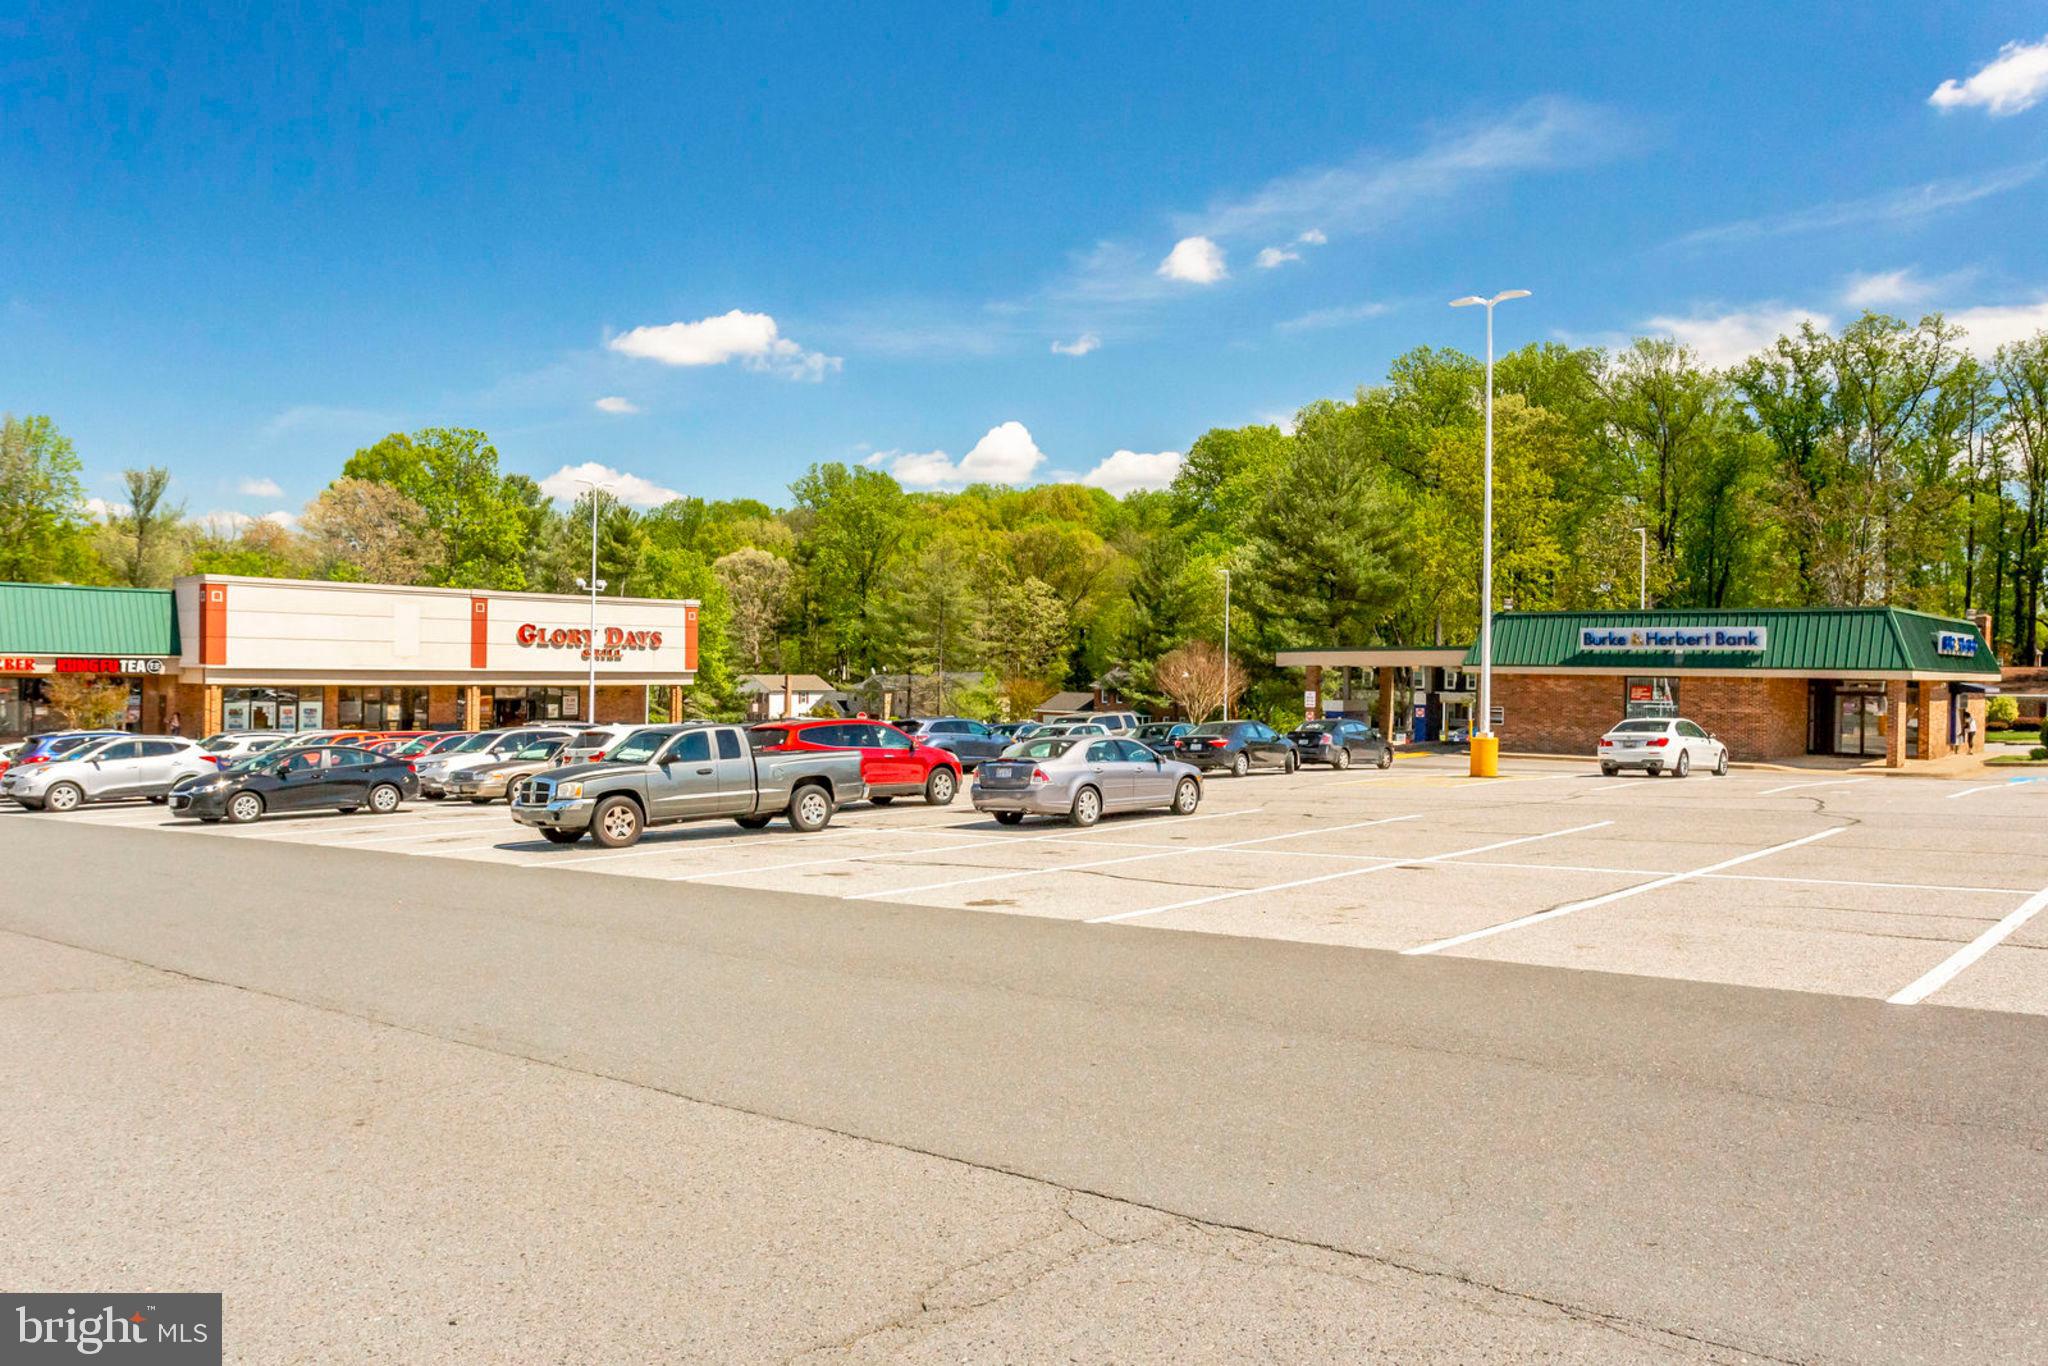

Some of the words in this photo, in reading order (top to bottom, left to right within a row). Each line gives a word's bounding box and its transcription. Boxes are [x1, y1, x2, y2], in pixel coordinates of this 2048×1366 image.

[516, 623, 598, 649] GLORY
[604, 627, 662, 651] DAYS
[1583, 631, 1627, 646] Burke
[1631, 632, 1643, 646] &
[1646, 631, 1710, 646] Herbert
[1715, 631, 1759, 646] Bank
[0, 657, 36, 671] BER
[56, 657, 99, 673] KUNG
[100, 658, 120, 673] FU
[120, 659, 146, 673] TEA
